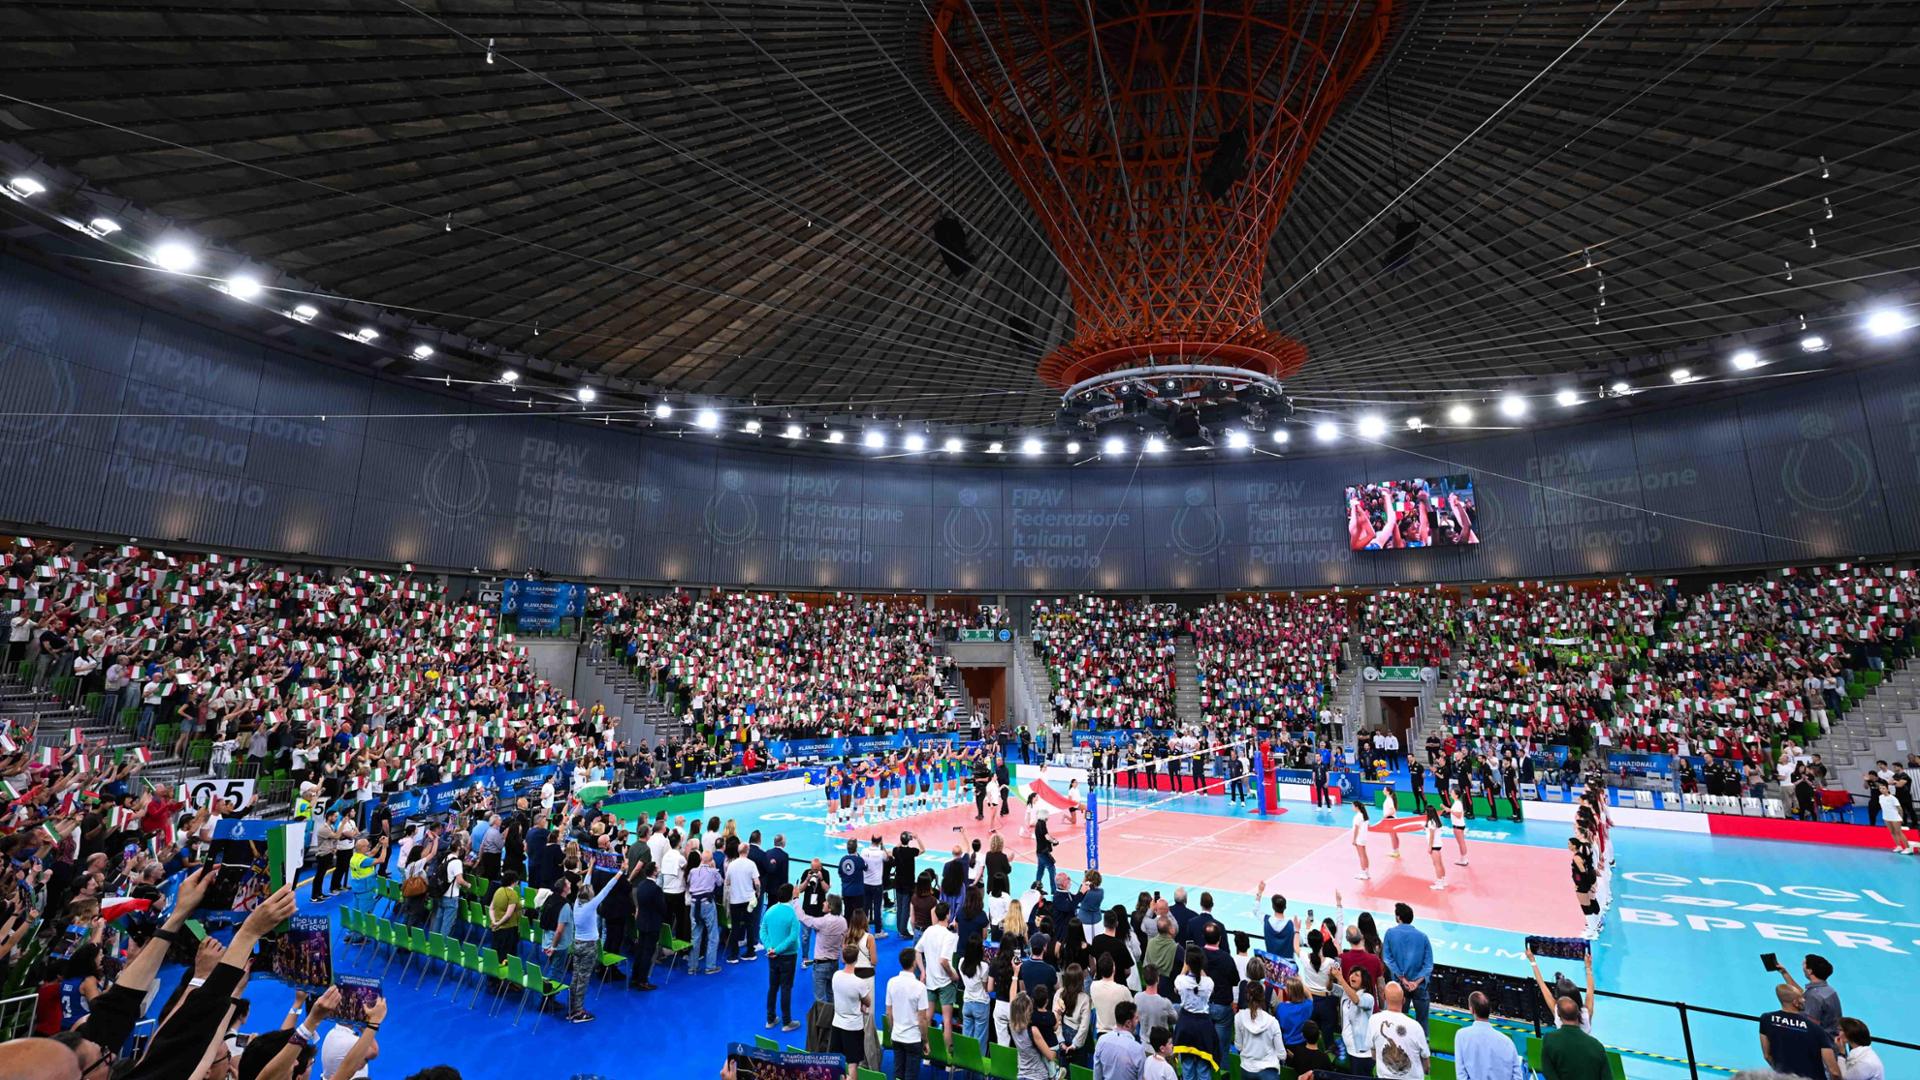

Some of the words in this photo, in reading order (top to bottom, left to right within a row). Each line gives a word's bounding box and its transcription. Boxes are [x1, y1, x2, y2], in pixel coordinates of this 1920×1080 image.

[521, 436, 589, 468] FIPAV
[1526, 450, 1599, 479] FIPAV
[518, 466, 662, 502] Federazione
[784, 475, 840, 496] FIPAV
[1247, 480, 1305, 498] FIPAV
[515, 489, 611, 523] Italiana
[1012, 488, 1065, 506] FIPAV
[782, 497, 904, 522] Federazione
[1012, 508, 1130, 527] Federazione
[514, 515, 625, 549] Pallavolo
[780, 517, 862, 541] Italiana
[1013, 529, 1086, 547] Italiana
[1250, 521, 1332, 541] Italiana
[1535, 524, 1662, 551] Pallavolo
[779, 542, 872, 564] Pallavolo
[1012, 549, 1100, 568] Pallavolo
[1250, 544, 1350, 565] Pallavolo
[1622, 872, 1905, 907] enel
[1660, 894, 1890, 924] DHL
[1771, 1015, 1808, 1029] ITALIA
